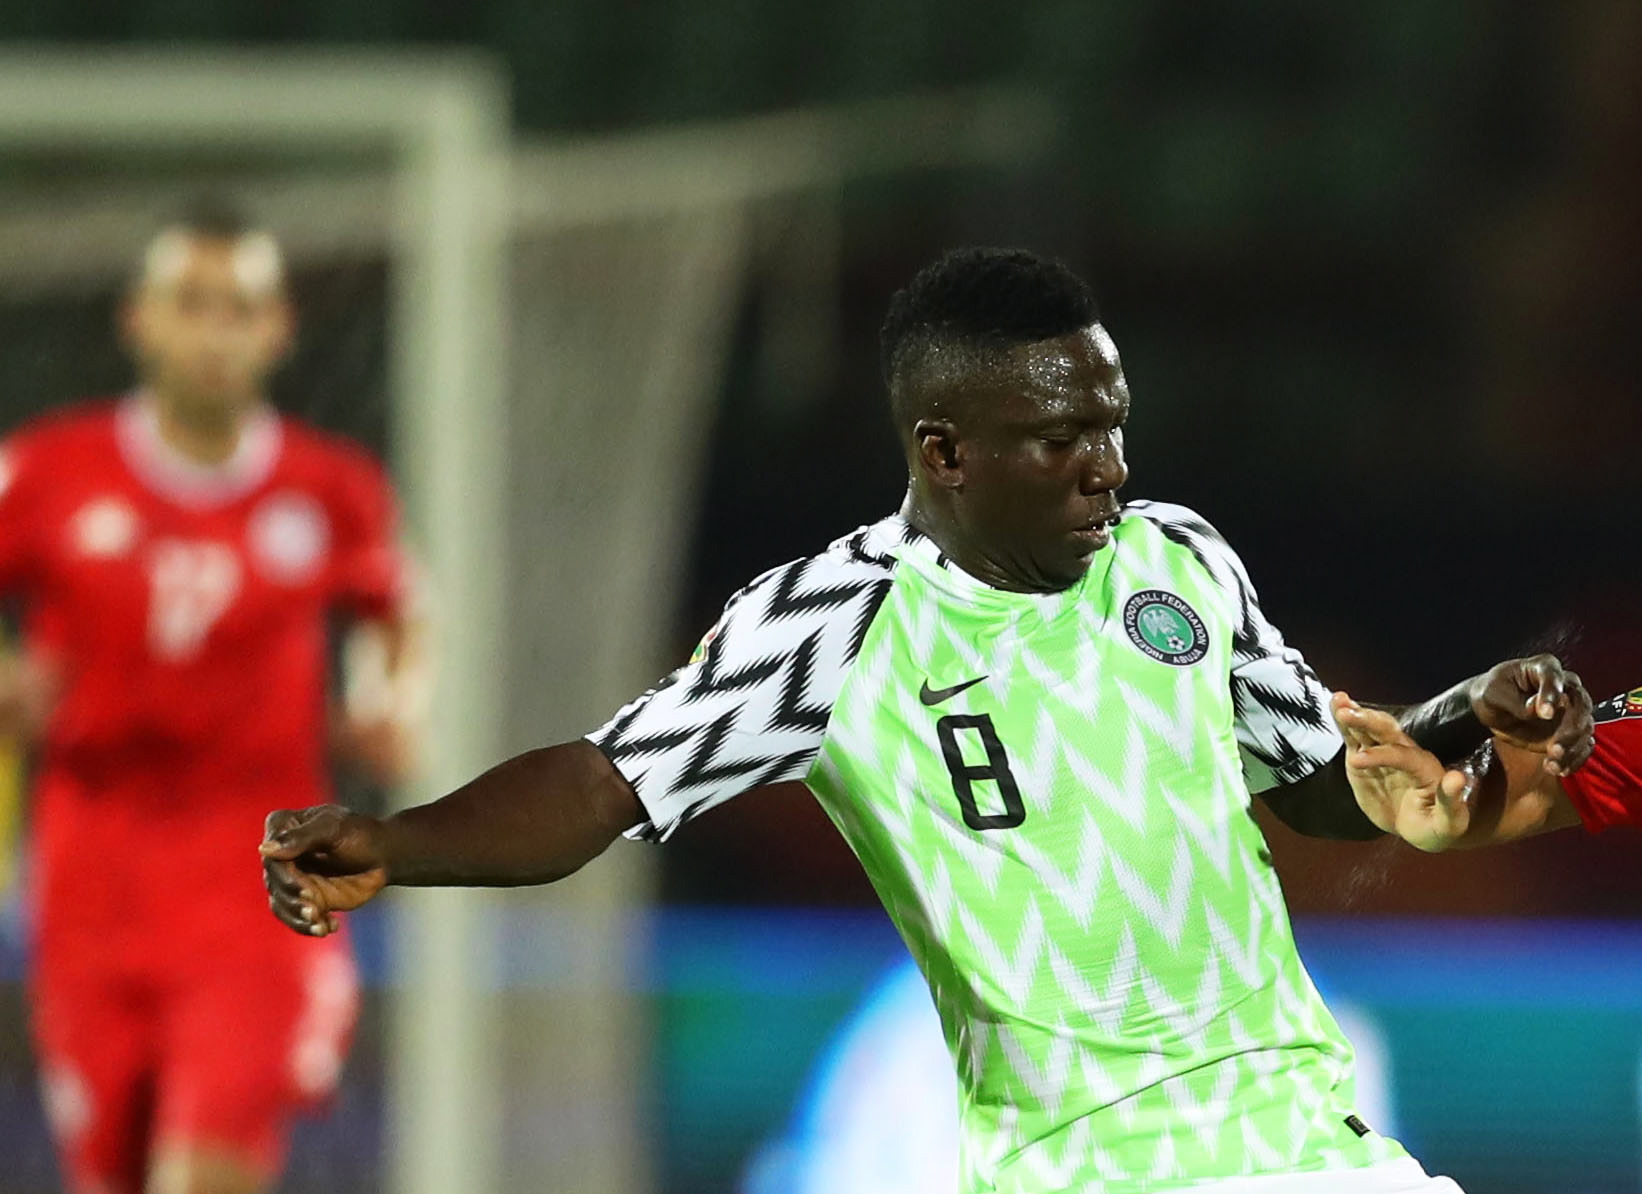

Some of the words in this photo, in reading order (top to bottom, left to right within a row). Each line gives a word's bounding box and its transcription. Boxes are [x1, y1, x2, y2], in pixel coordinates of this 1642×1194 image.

[1126, 593, 1160, 626] FOOTBALL
[1161, 594, 1206, 646] FEDERATION
[1128, 627, 1163, 660] NIGERIA
[1173, 649, 1203, 664] ABUJA
[937, 713, 1026, 831] 8
